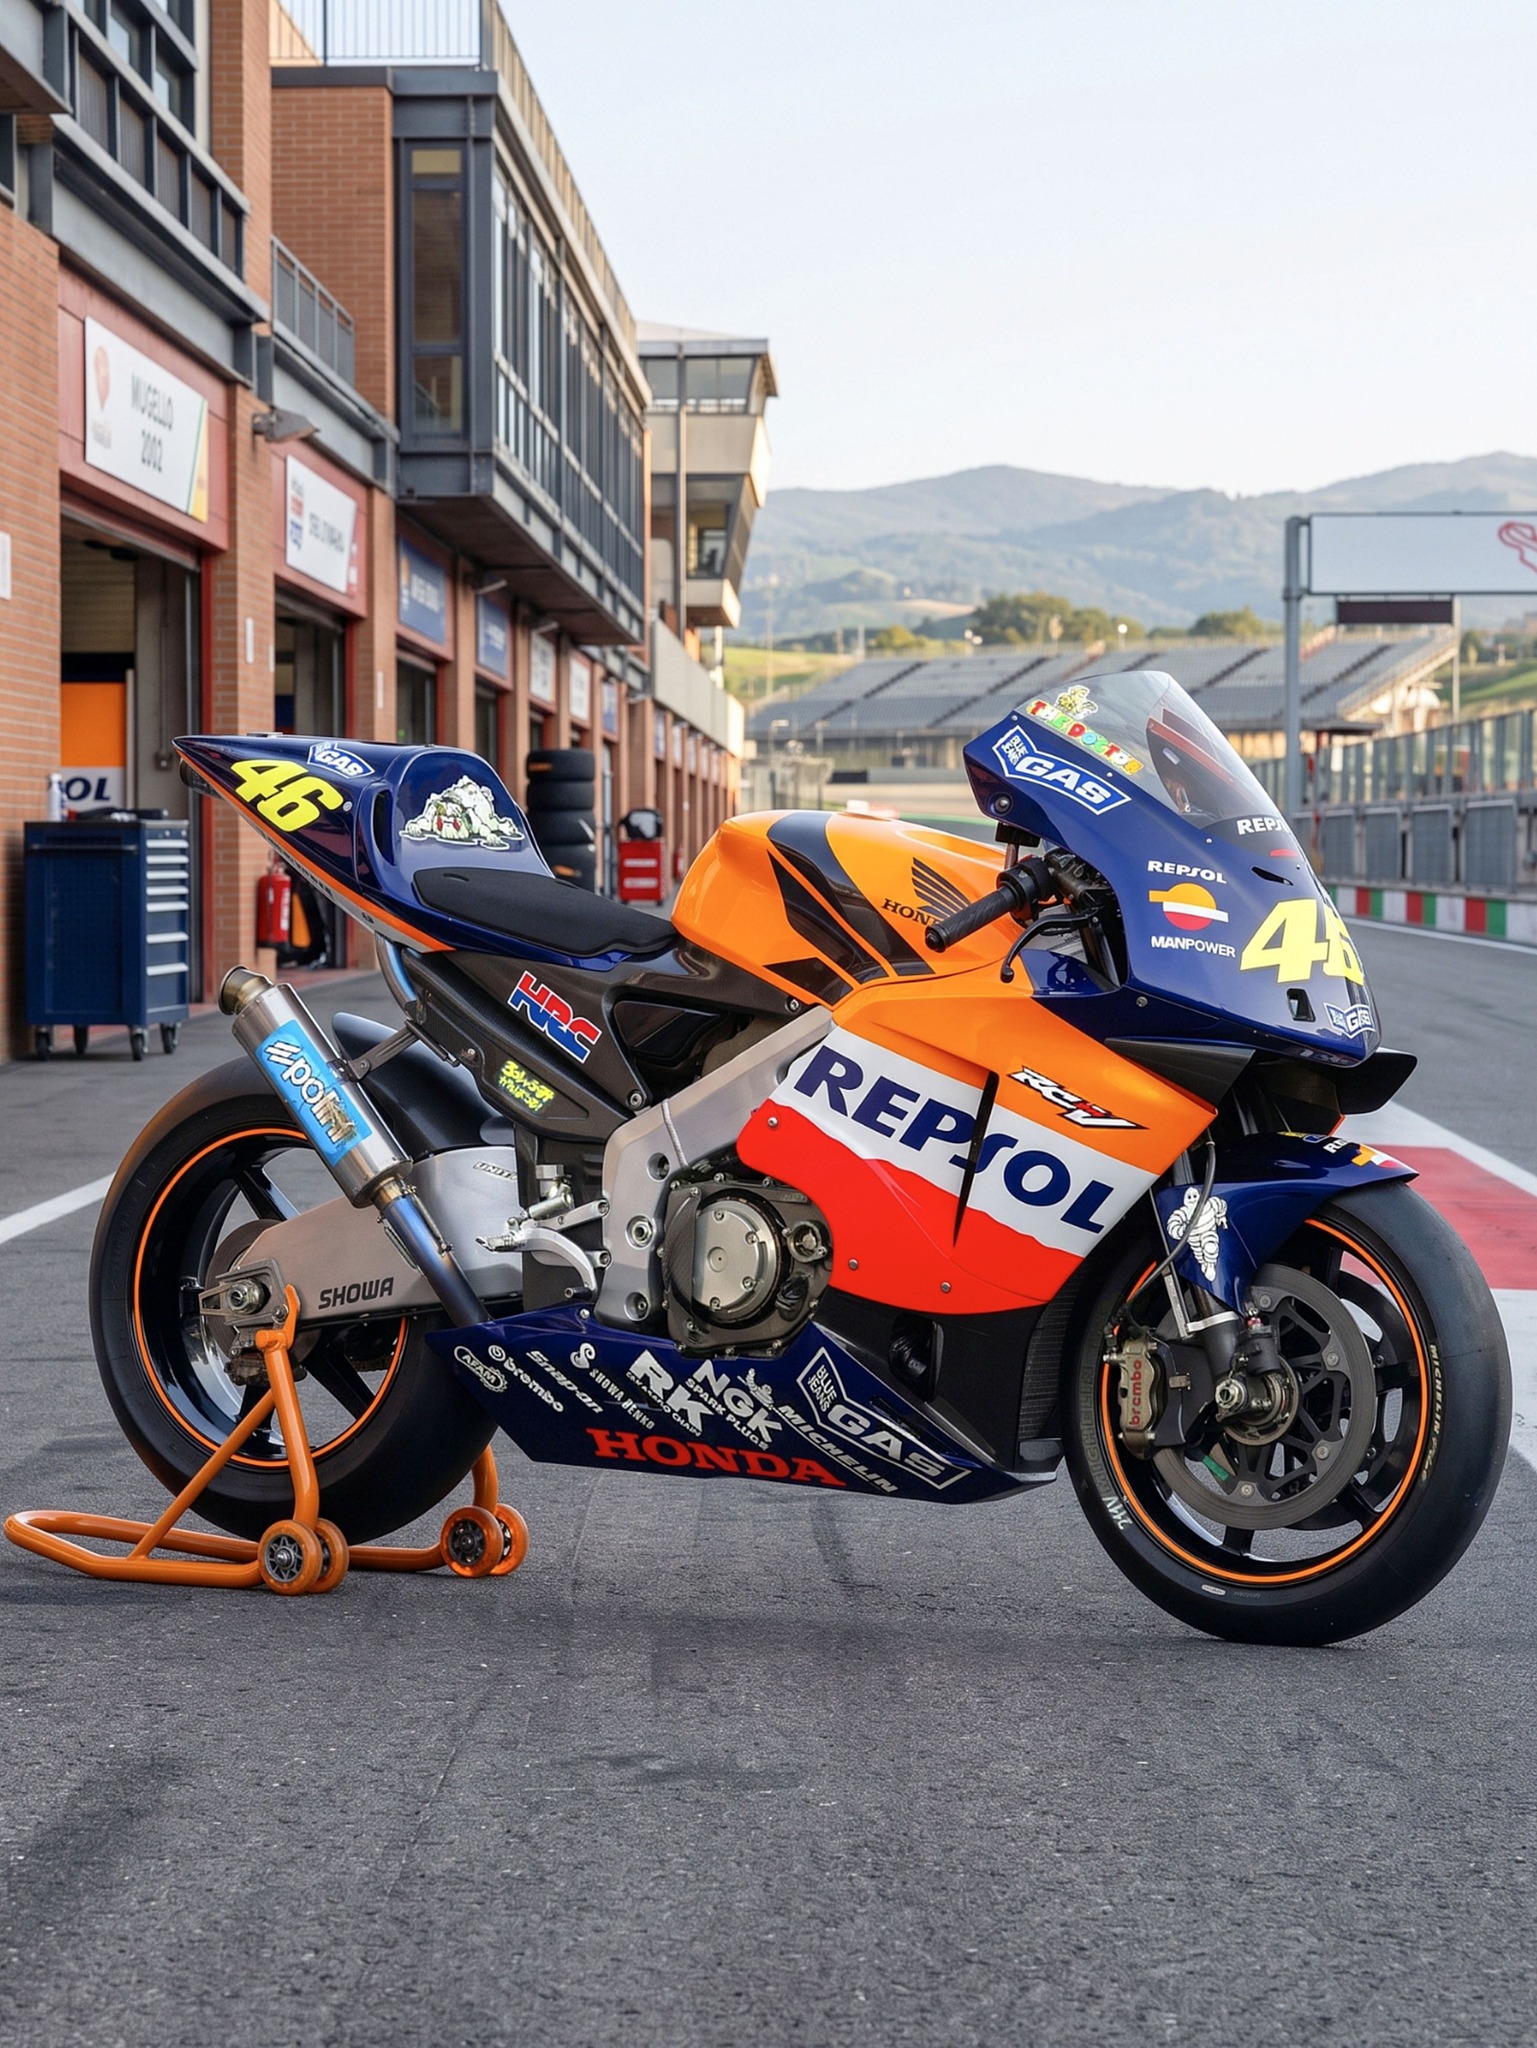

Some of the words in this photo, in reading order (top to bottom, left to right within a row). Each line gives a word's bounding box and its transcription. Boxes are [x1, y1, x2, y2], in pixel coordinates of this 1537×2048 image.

[132, 373, 174, 432] MUGELLO
[141, 429, 163, 473] 2002
[60, 777, 111, 801] OL
[230, 759, 344, 832] 46
[1015, 756, 1111, 804] GAS
[1147, 860, 1227, 884] REPSOL
[881, 898, 940, 926] HON
[1151, 936, 1236, 958] MANPOWER
[1240, 899, 1364, 986] 46
[508, 970, 602, 1063] HRC
[793, 1044, 1115, 1235] REPSOL
[318, 1277, 394, 1310] SHOWA
[461, 1354, 497, 1383] AFAM
[503, 1356, 564, 1413] brembo
[590, 1367, 622, 1401] SHOWA
[628, 1349, 714, 1432] RK
[808, 1375, 830, 1412] JEANS
[816, 1364, 838, 1405] BLUE
[1429, 1344, 1442, 1434] MICHELIN
[685, 1377, 727, 1415] SPARK
[724, 1414, 770, 1451] PLUGS
[691, 1359, 783, 1444] NGK
[586, 1428, 846, 1487] HONDA
[778, 1405, 898, 1493] MICHELIN
[827, 1403, 945, 1477] GAS
